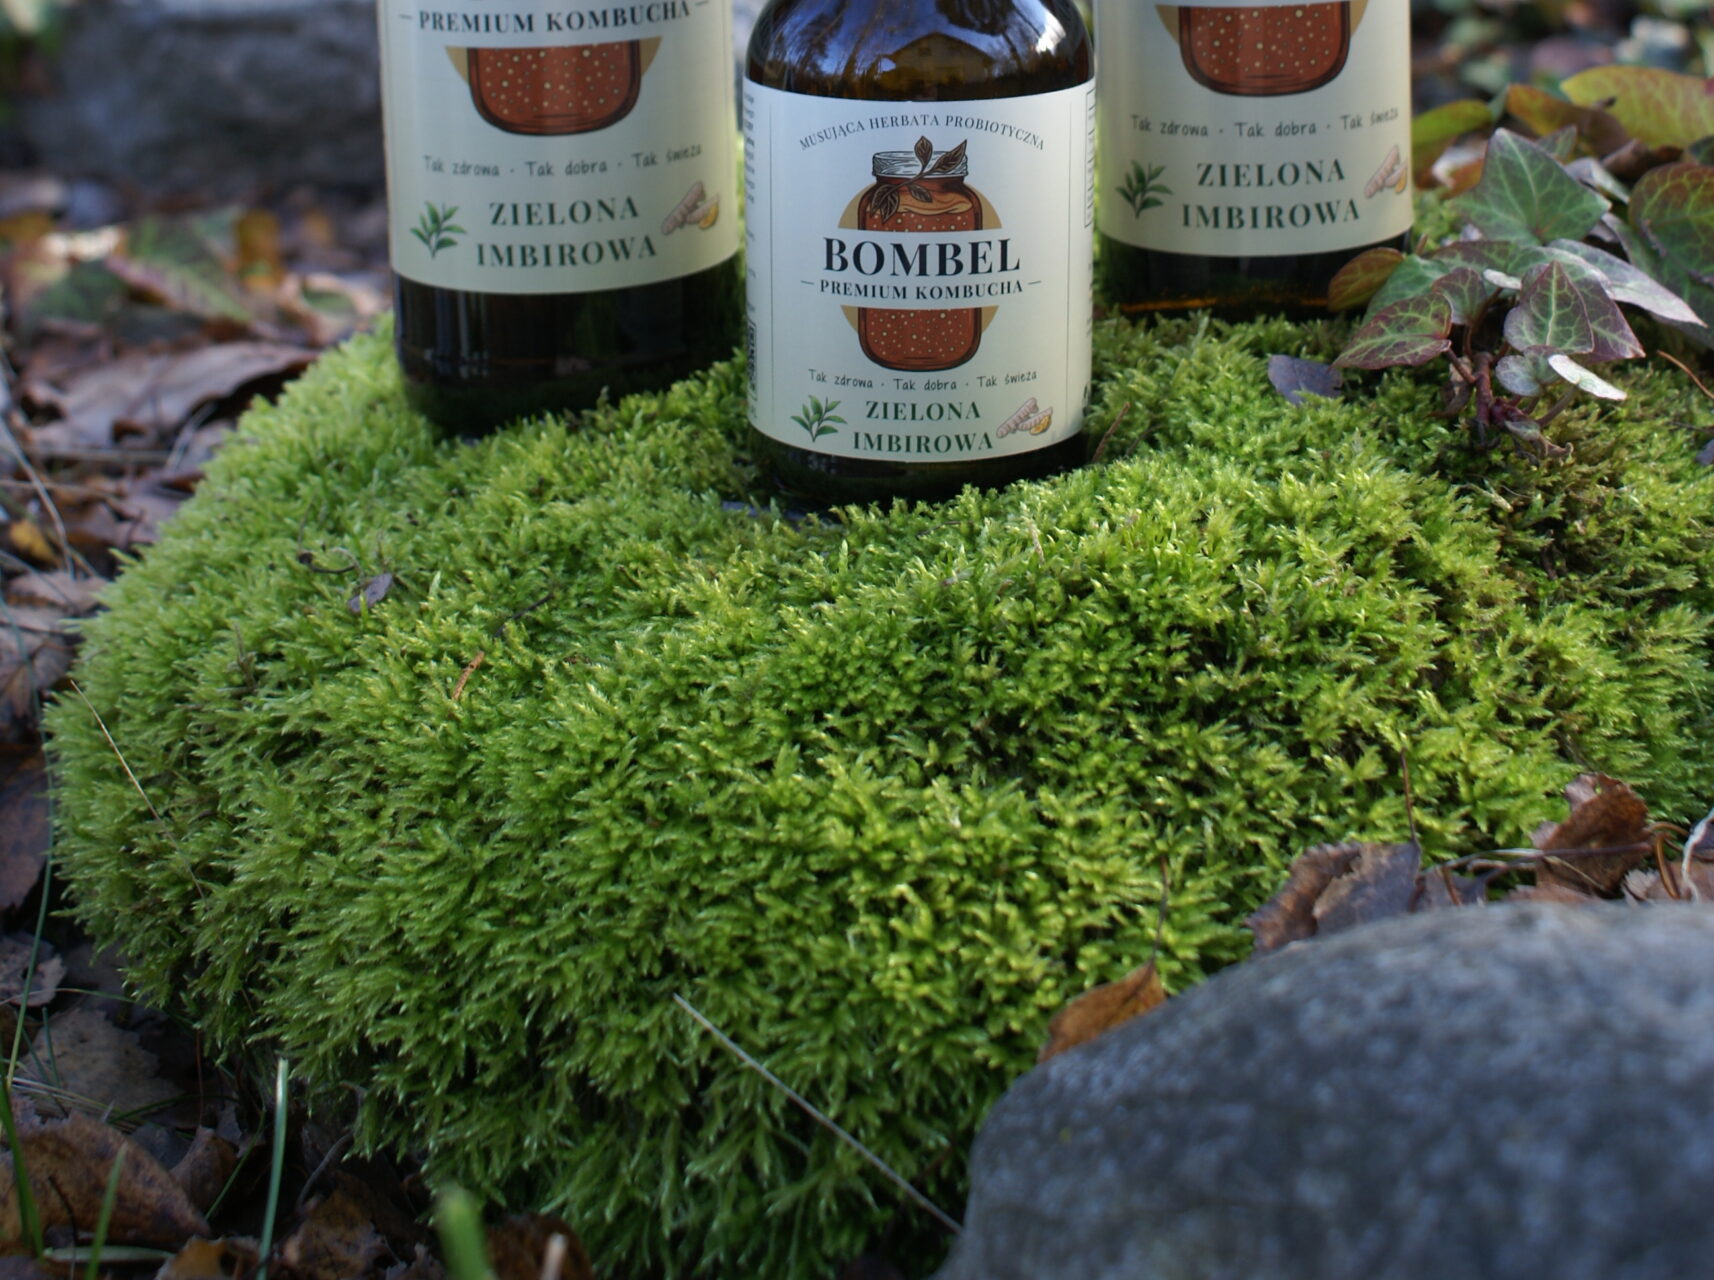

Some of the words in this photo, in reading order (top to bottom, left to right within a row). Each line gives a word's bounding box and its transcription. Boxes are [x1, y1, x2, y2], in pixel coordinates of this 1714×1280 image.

[419, 10, 535, 34] PREMIUM
[547, 0, 691, 33] KOMBUCHA
[799, 119, 866, 152] MUSUJĄCA
[869, 113, 940, 130] HERBATA
[945, 114, 1045, 152] PROBIOTYCZNA
[1130, 113, 1152, 131] Tak
[1160, 119, 1208, 138] zdrowa
[1234, 121, 1264, 138] Tak
[1275, 120, 1317, 137] dobra
[1339, 113, 1363, 131] Tak
[423, 154, 445, 173] Tak
[452, 158, 500, 178] zdrowa
[525, 160, 555, 178] Tak
[565, 157, 607, 176] dobra
[631, 151, 658, 169] Tak
[1196, 158, 1345, 188] ZIELONA
[489, 195, 639, 227] ZIELONA
[1182, 198, 1360, 230] IMBIROWA
[476, 235, 658, 268] IMBIROWA
[824, 237, 1020, 278] BOMBEL
[820, 278, 908, 300] PREMIUM
[916, 279, 1024, 300] KOMBUCHA
[808, 368, 828, 384] Tak
[834, 370, 873, 389] zdrowa
[893, 377, 916, 392] Tak
[924, 377, 957, 392] dobra
[976, 375, 998, 388] Tak
[866, 399, 982, 422] ZIELONA
[853, 431, 995, 455] IMBIROWA
